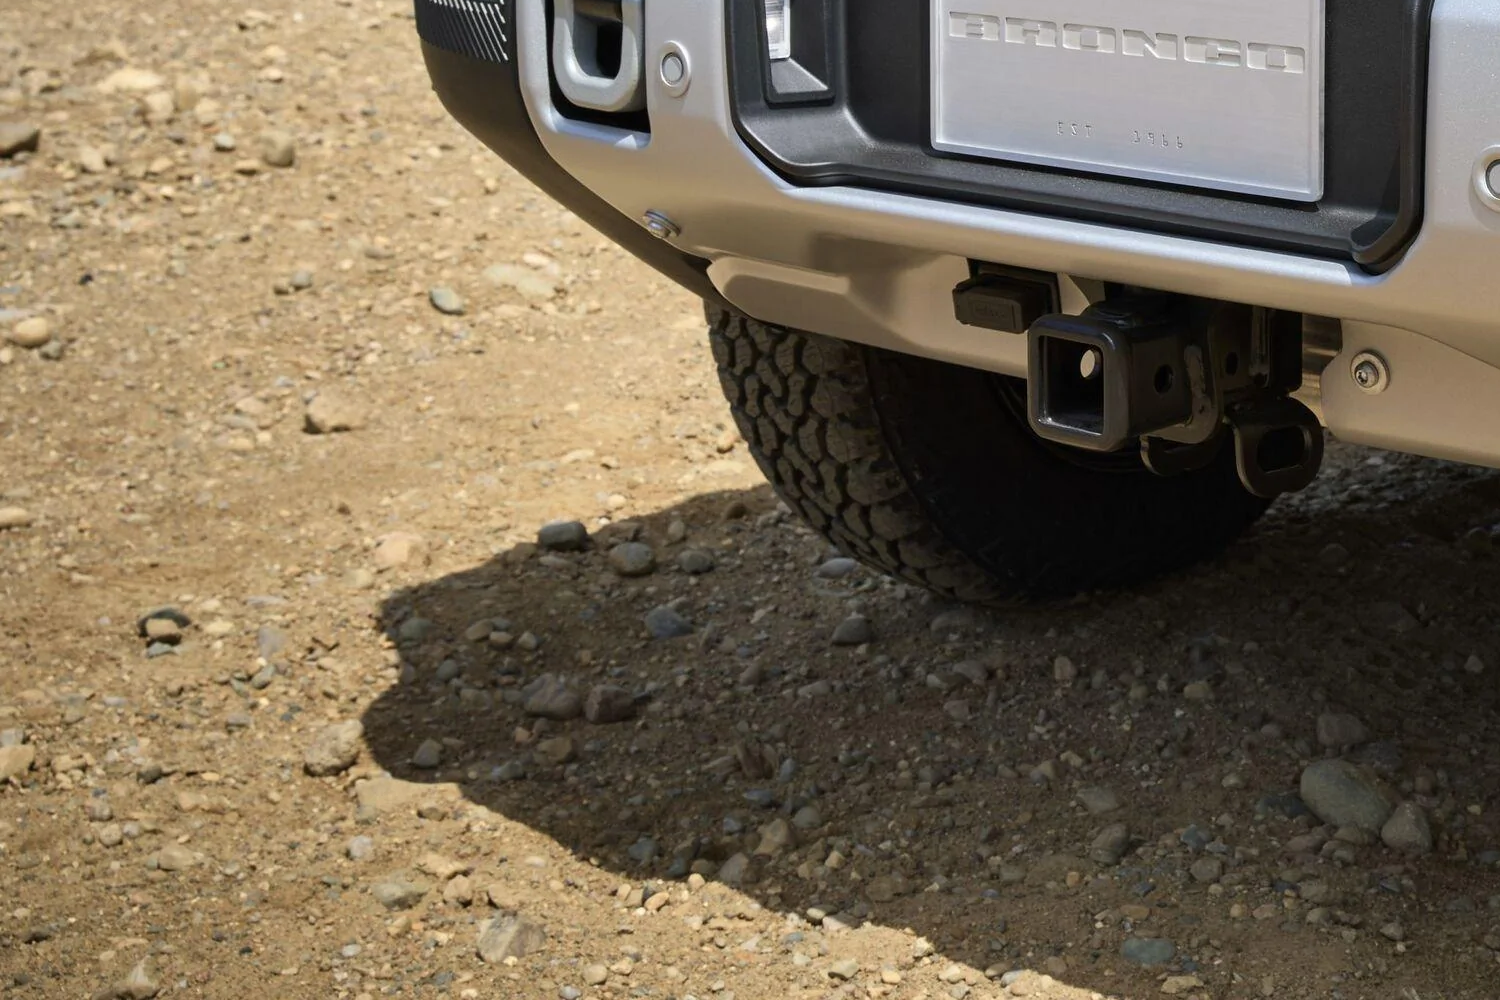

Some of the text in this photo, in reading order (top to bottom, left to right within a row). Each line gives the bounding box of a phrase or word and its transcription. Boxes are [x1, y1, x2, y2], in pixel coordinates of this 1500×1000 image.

[948, 10, 1306, 74] BRONCO
[1056, 120, 1184, 150] EST 1966
